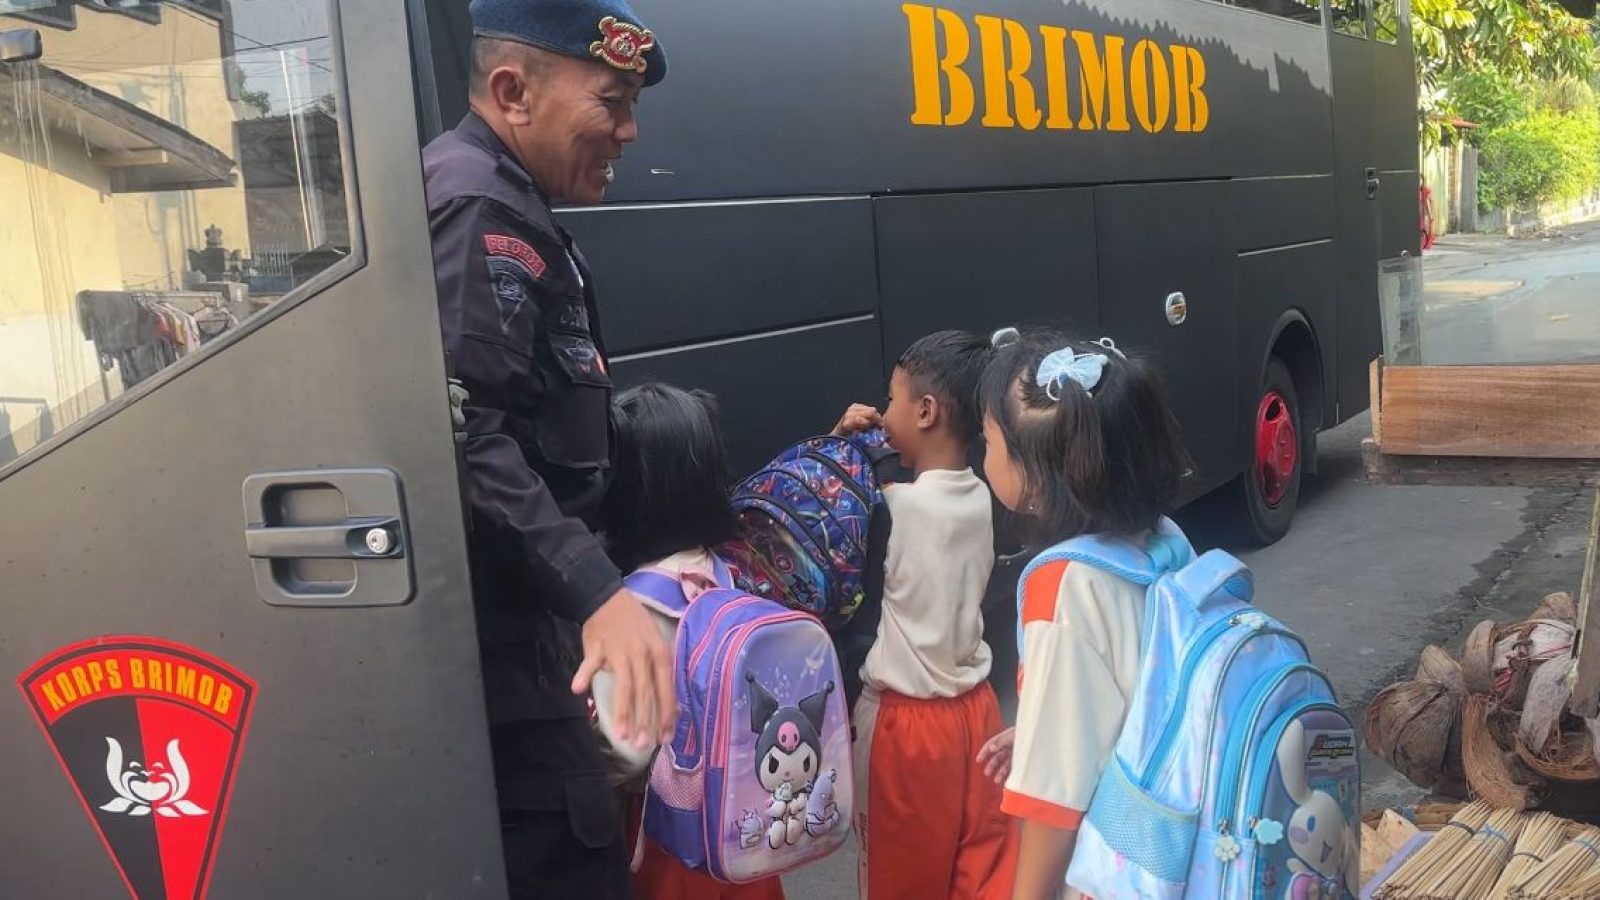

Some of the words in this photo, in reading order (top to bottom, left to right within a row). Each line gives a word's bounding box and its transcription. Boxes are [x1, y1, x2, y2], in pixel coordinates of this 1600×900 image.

[902, 3, 1210, 133] BRIMOB
[41, 658, 123, 712] KORPS
[128, 657, 234, 716] BRIMOB
